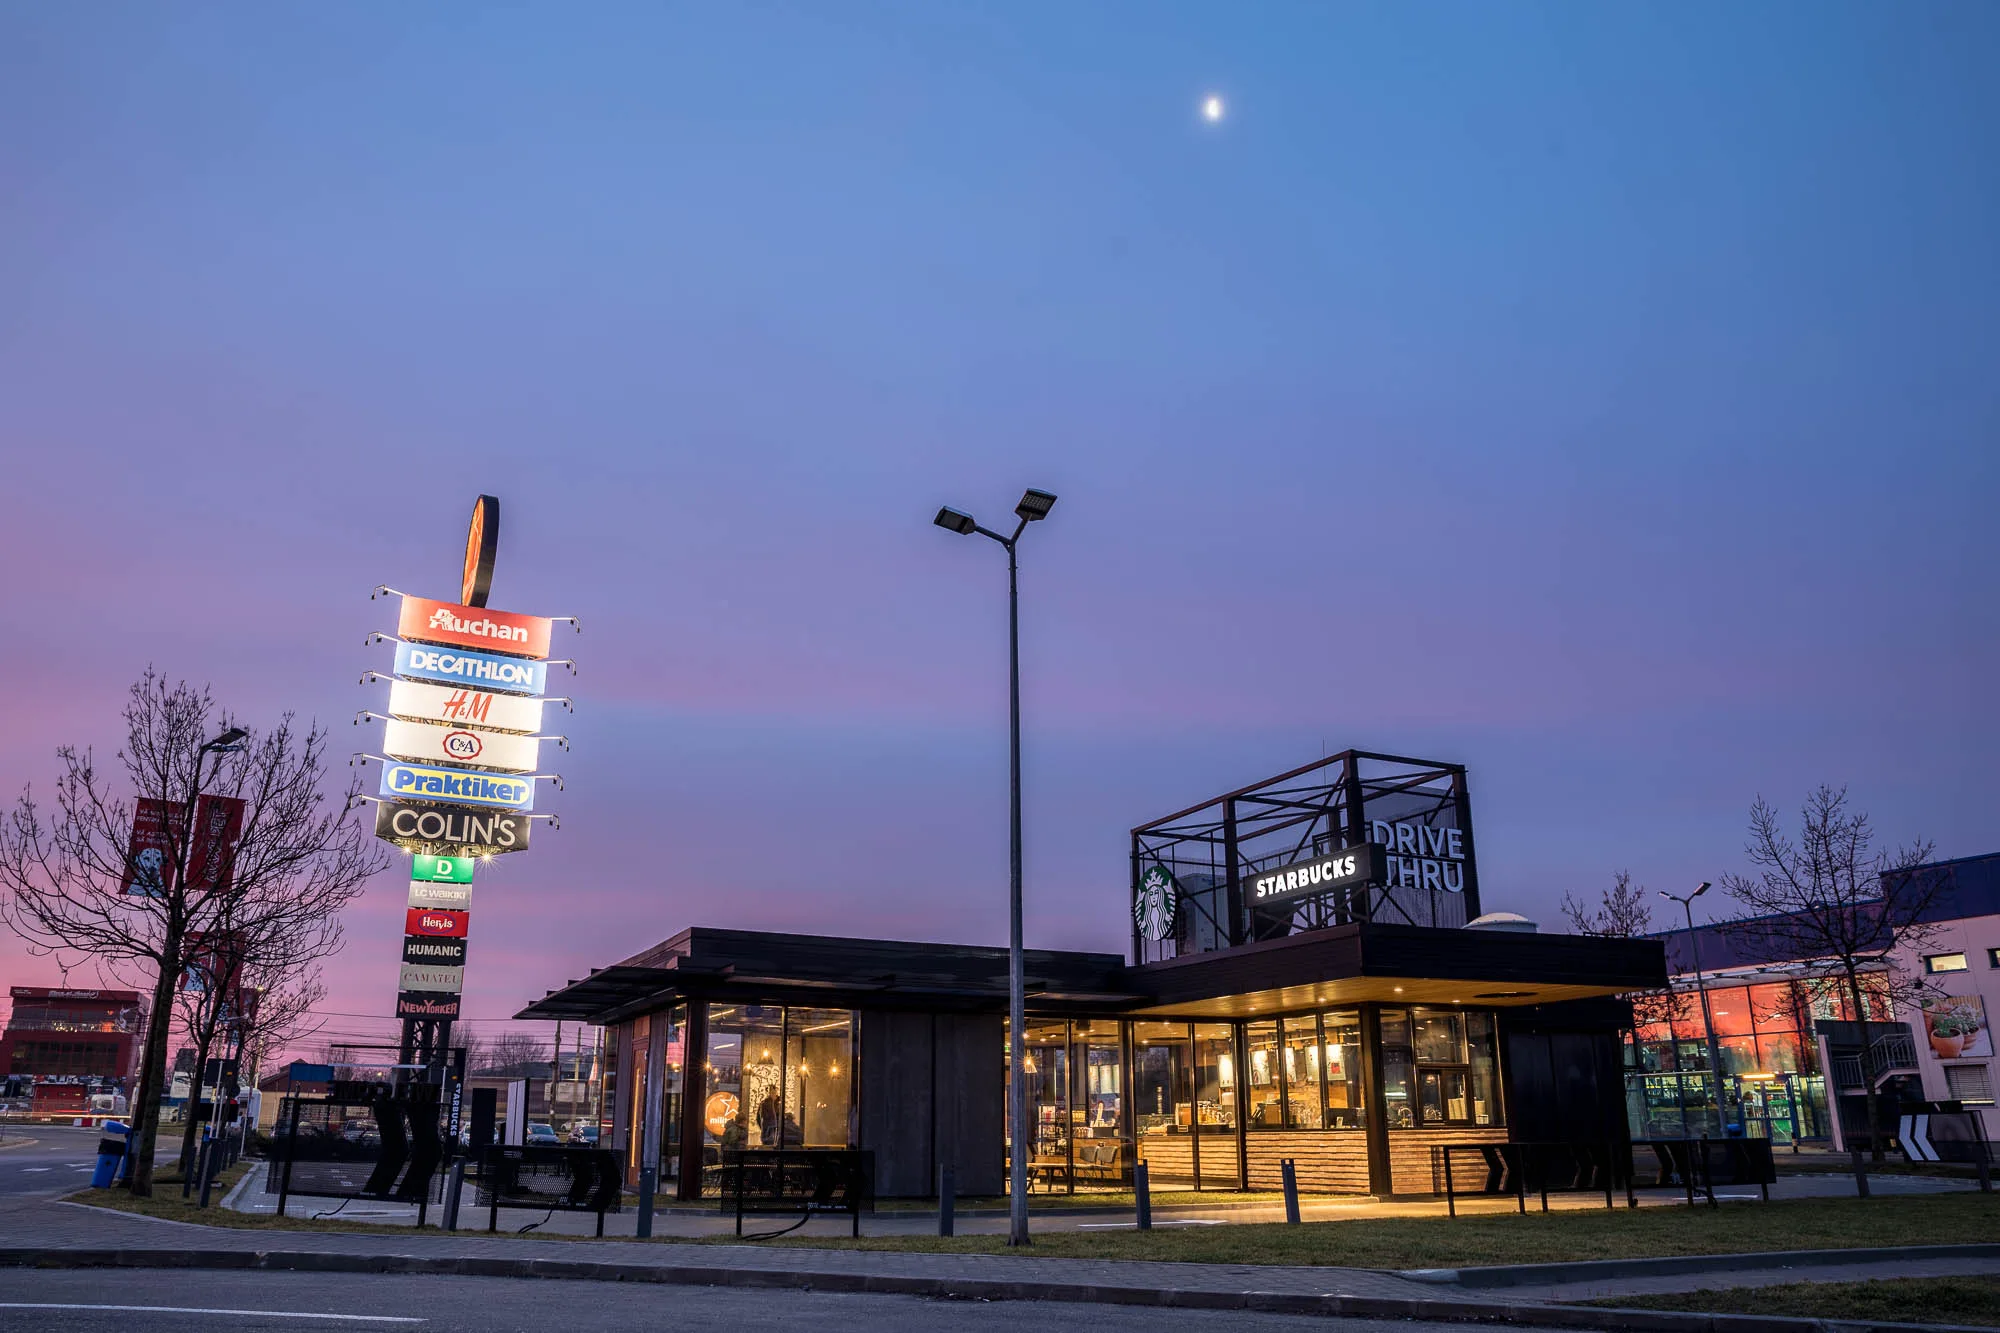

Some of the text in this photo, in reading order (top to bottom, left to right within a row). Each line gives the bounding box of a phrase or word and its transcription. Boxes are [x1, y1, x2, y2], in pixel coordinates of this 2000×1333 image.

[429, 608, 528, 643] Auchan
[410, 650, 532, 685] DECATHLON
[443, 689, 493, 723] H&M
[449, 738, 475, 754] C&A
[394, 769, 526, 801] Praktiker
[392, 809, 516, 846] COLIN'S
[1372, 820, 1465, 859] DRIVE
[1256, 855, 1356, 898] STARBUCKS
[1386, 856, 1464, 893] THRU
[415, 889, 428, 897] LC
[422, 916, 453, 930] Hervis
[407, 944, 462, 957] HUMANIC
